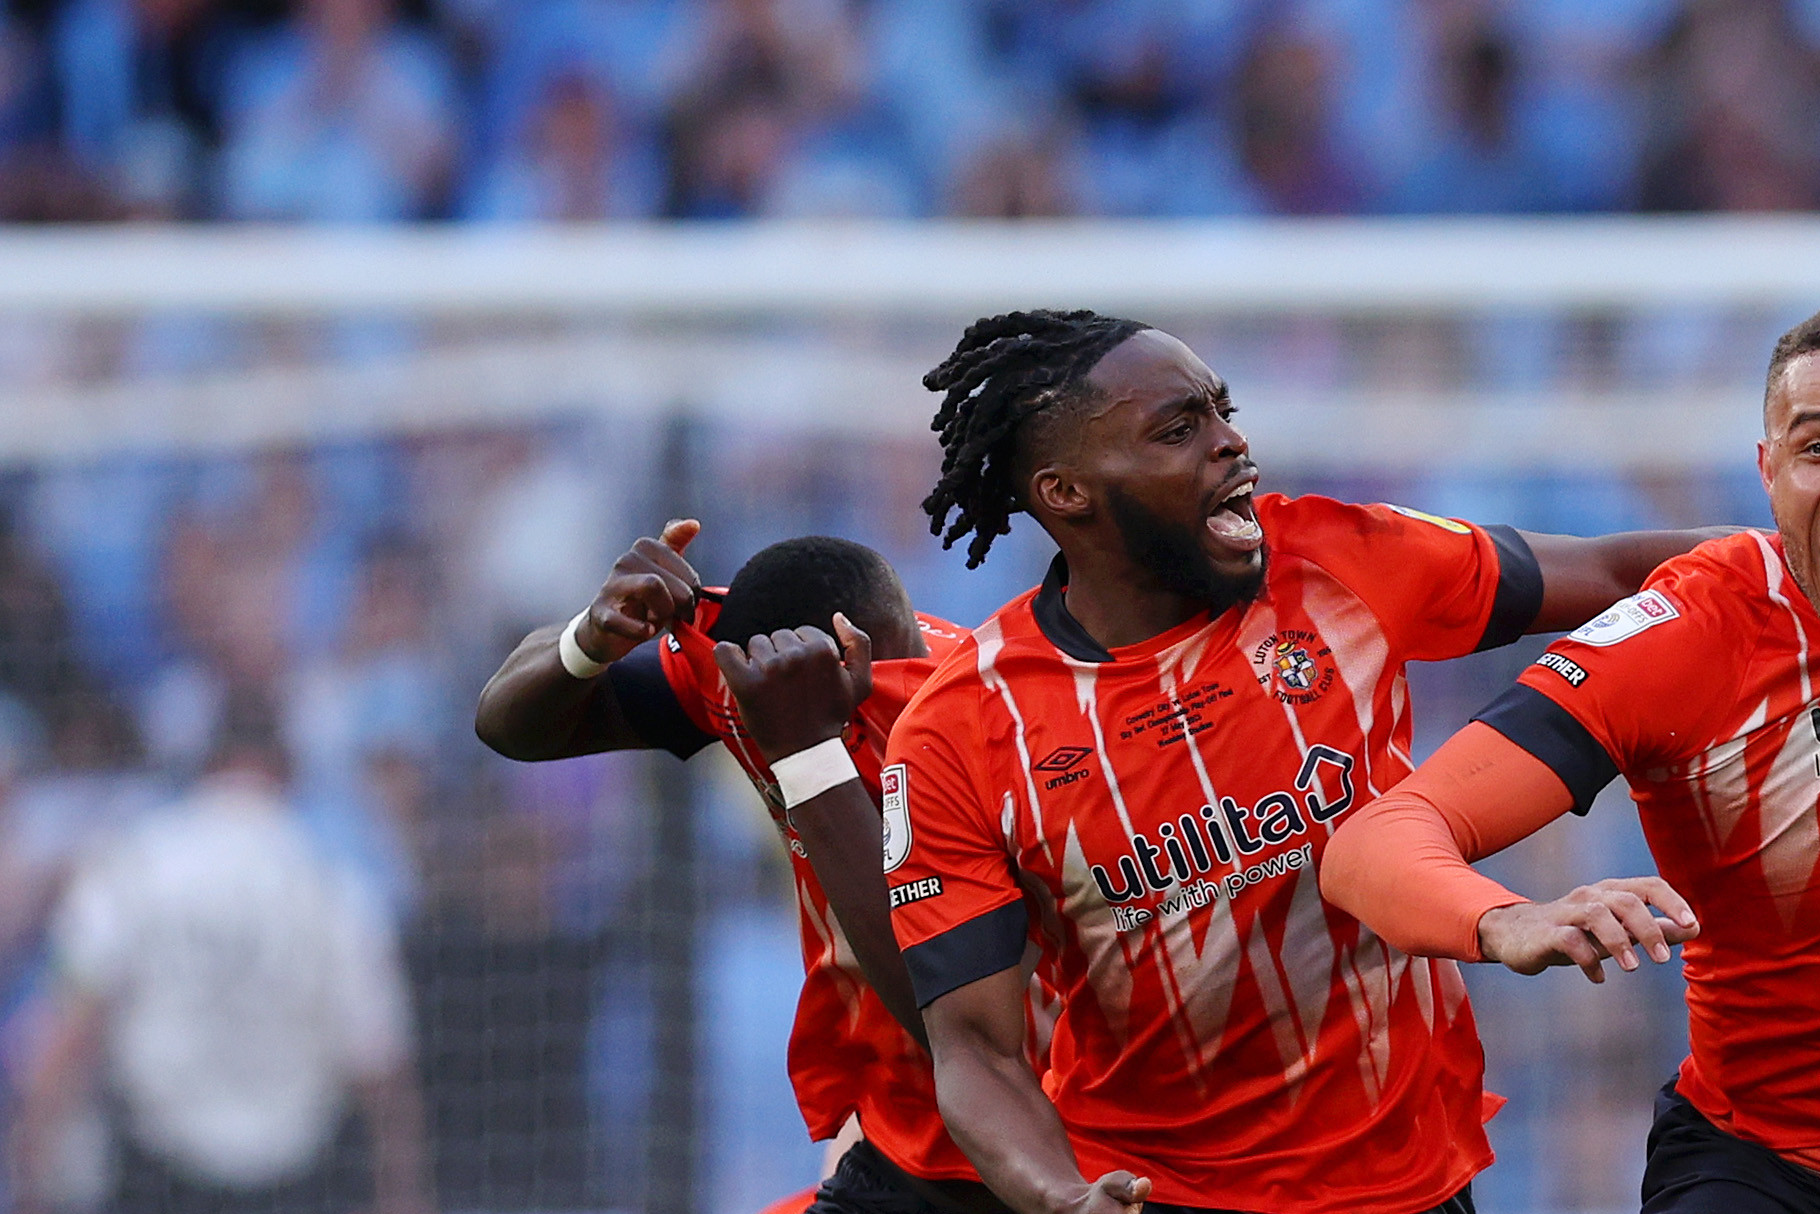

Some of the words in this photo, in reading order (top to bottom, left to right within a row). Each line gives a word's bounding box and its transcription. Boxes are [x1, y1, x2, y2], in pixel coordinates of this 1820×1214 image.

[1253, 634, 1279, 665] LUTON
[1280, 629, 1317, 644] TOWN
[1272, 689, 1322, 705] FOOTBALL
[1318, 667, 1335, 692] CLUB
[1044, 768, 1090, 790] umbro
[1090, 791, 1308, 902] utilita
[1111, 905, 1153, 932] life
[1156, 879, 1220, 917] with
[1225, 842, 1314, 898] power
